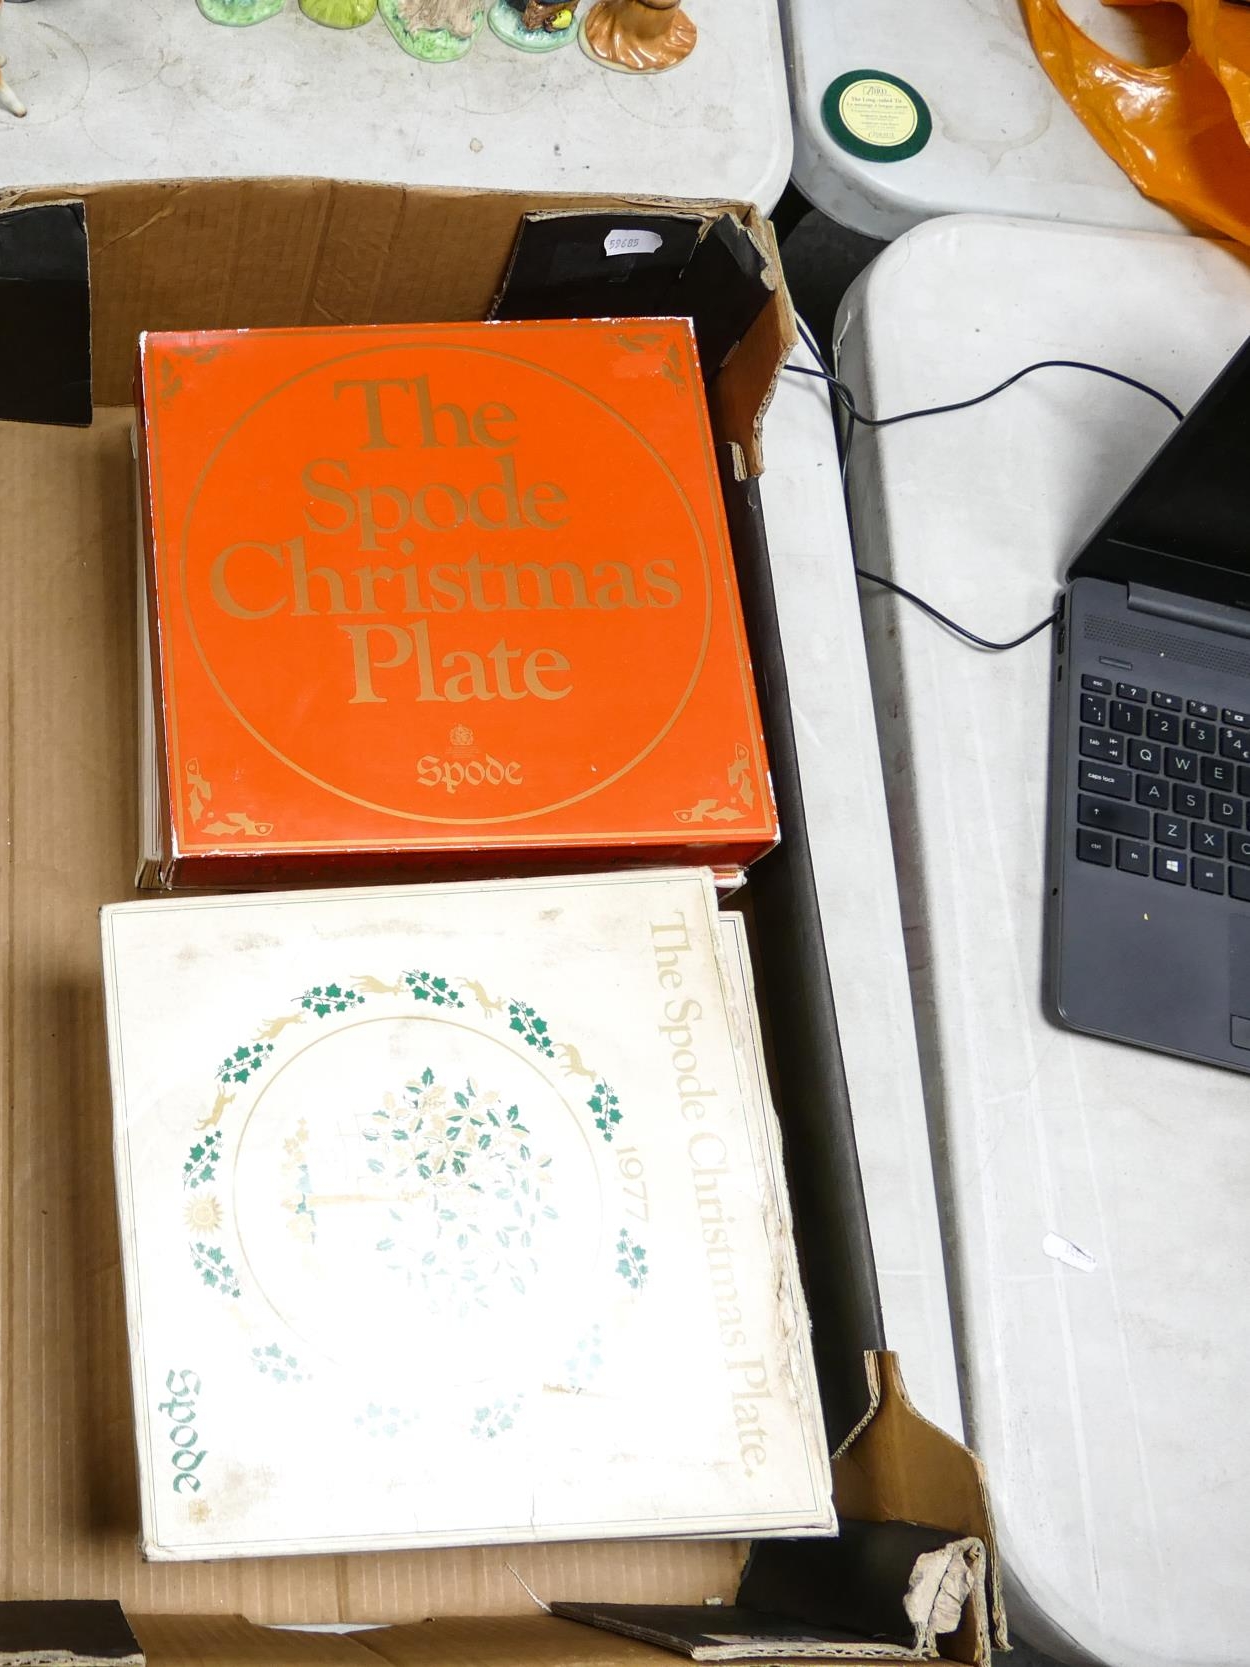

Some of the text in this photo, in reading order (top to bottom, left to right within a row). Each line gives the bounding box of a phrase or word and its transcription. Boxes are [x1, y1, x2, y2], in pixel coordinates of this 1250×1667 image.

[334, 374, 520, 453] The
[300, 456, 571, 553] Spode
[210, 538, 683, 620] Christmas
[342, 622, 575, 707] Plate
[1160, 720, 1169, 731] 2
[1197, 729, 1206, 740] 3
[1233, 739, 1242, 749] 4
[1140, 748, 1152, 762] Q
[1175, 756, 1190, 771] W
[416, 752, 524, 795] Spode
[1214, 767, 1223, 780] E
[1148, 785, 1160, 798] A
[1186, 794, 1196, 807] S
[1222, 803, 1234, 815] D
[1167, 824, 1178, 837] Z
[1203, 833, 1215, 847] X
[616, 1146, 649, 1224] 1977
[649, 910, 773, 1479] The Spode Christmas Plate.
[157, 1369, 209, 1494] Spode
